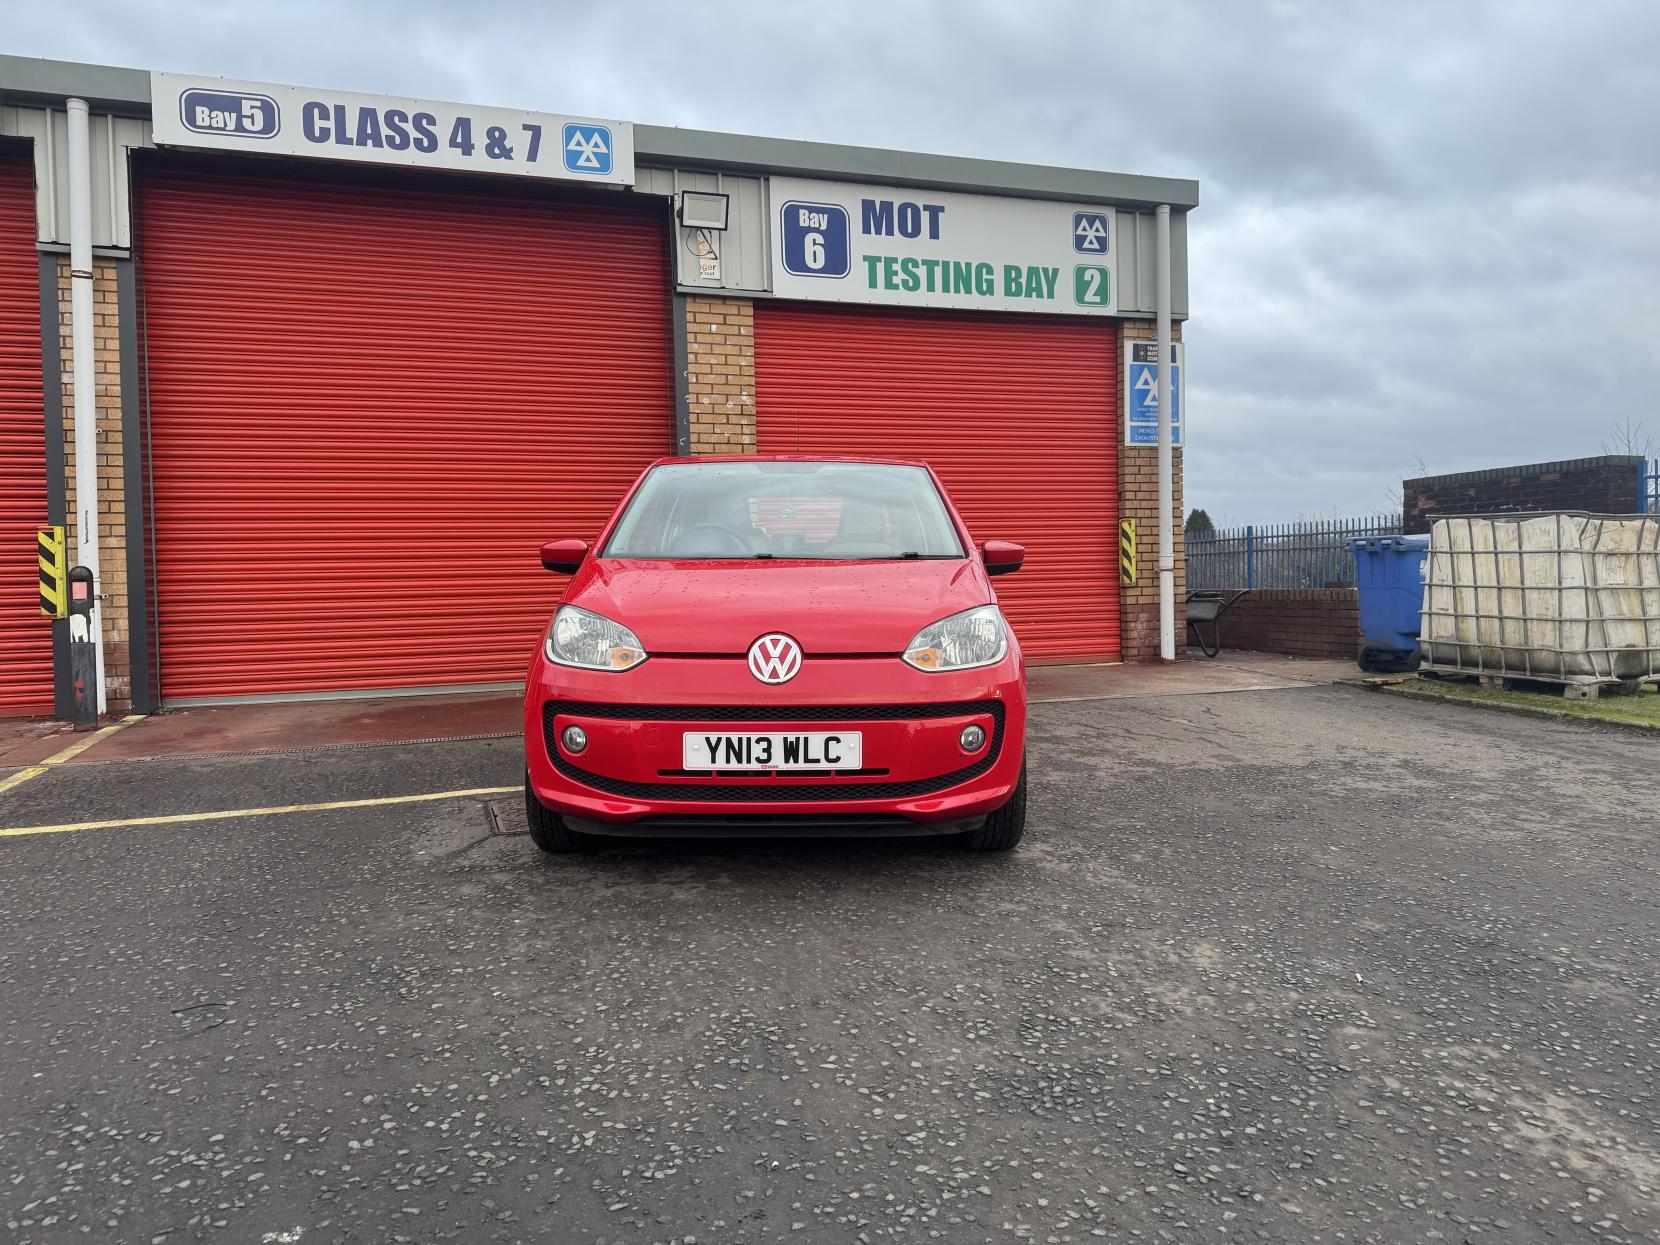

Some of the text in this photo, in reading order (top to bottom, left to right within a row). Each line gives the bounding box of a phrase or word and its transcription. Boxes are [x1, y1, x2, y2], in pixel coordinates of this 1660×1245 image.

[195, 99, 264, 132] Bay 5
[302, 101, 543, 163] CLASS 4 & 7
[798, 208, 828, 231] Bay
[861, 198, 945, 240] MOT
[804, 232, 825, 269] 6
[862, 254, 1060, 300] TESTING BAY
[1083, 268, 1101, 303] 2
[704, 735, 842, 765] YN13 WLC
